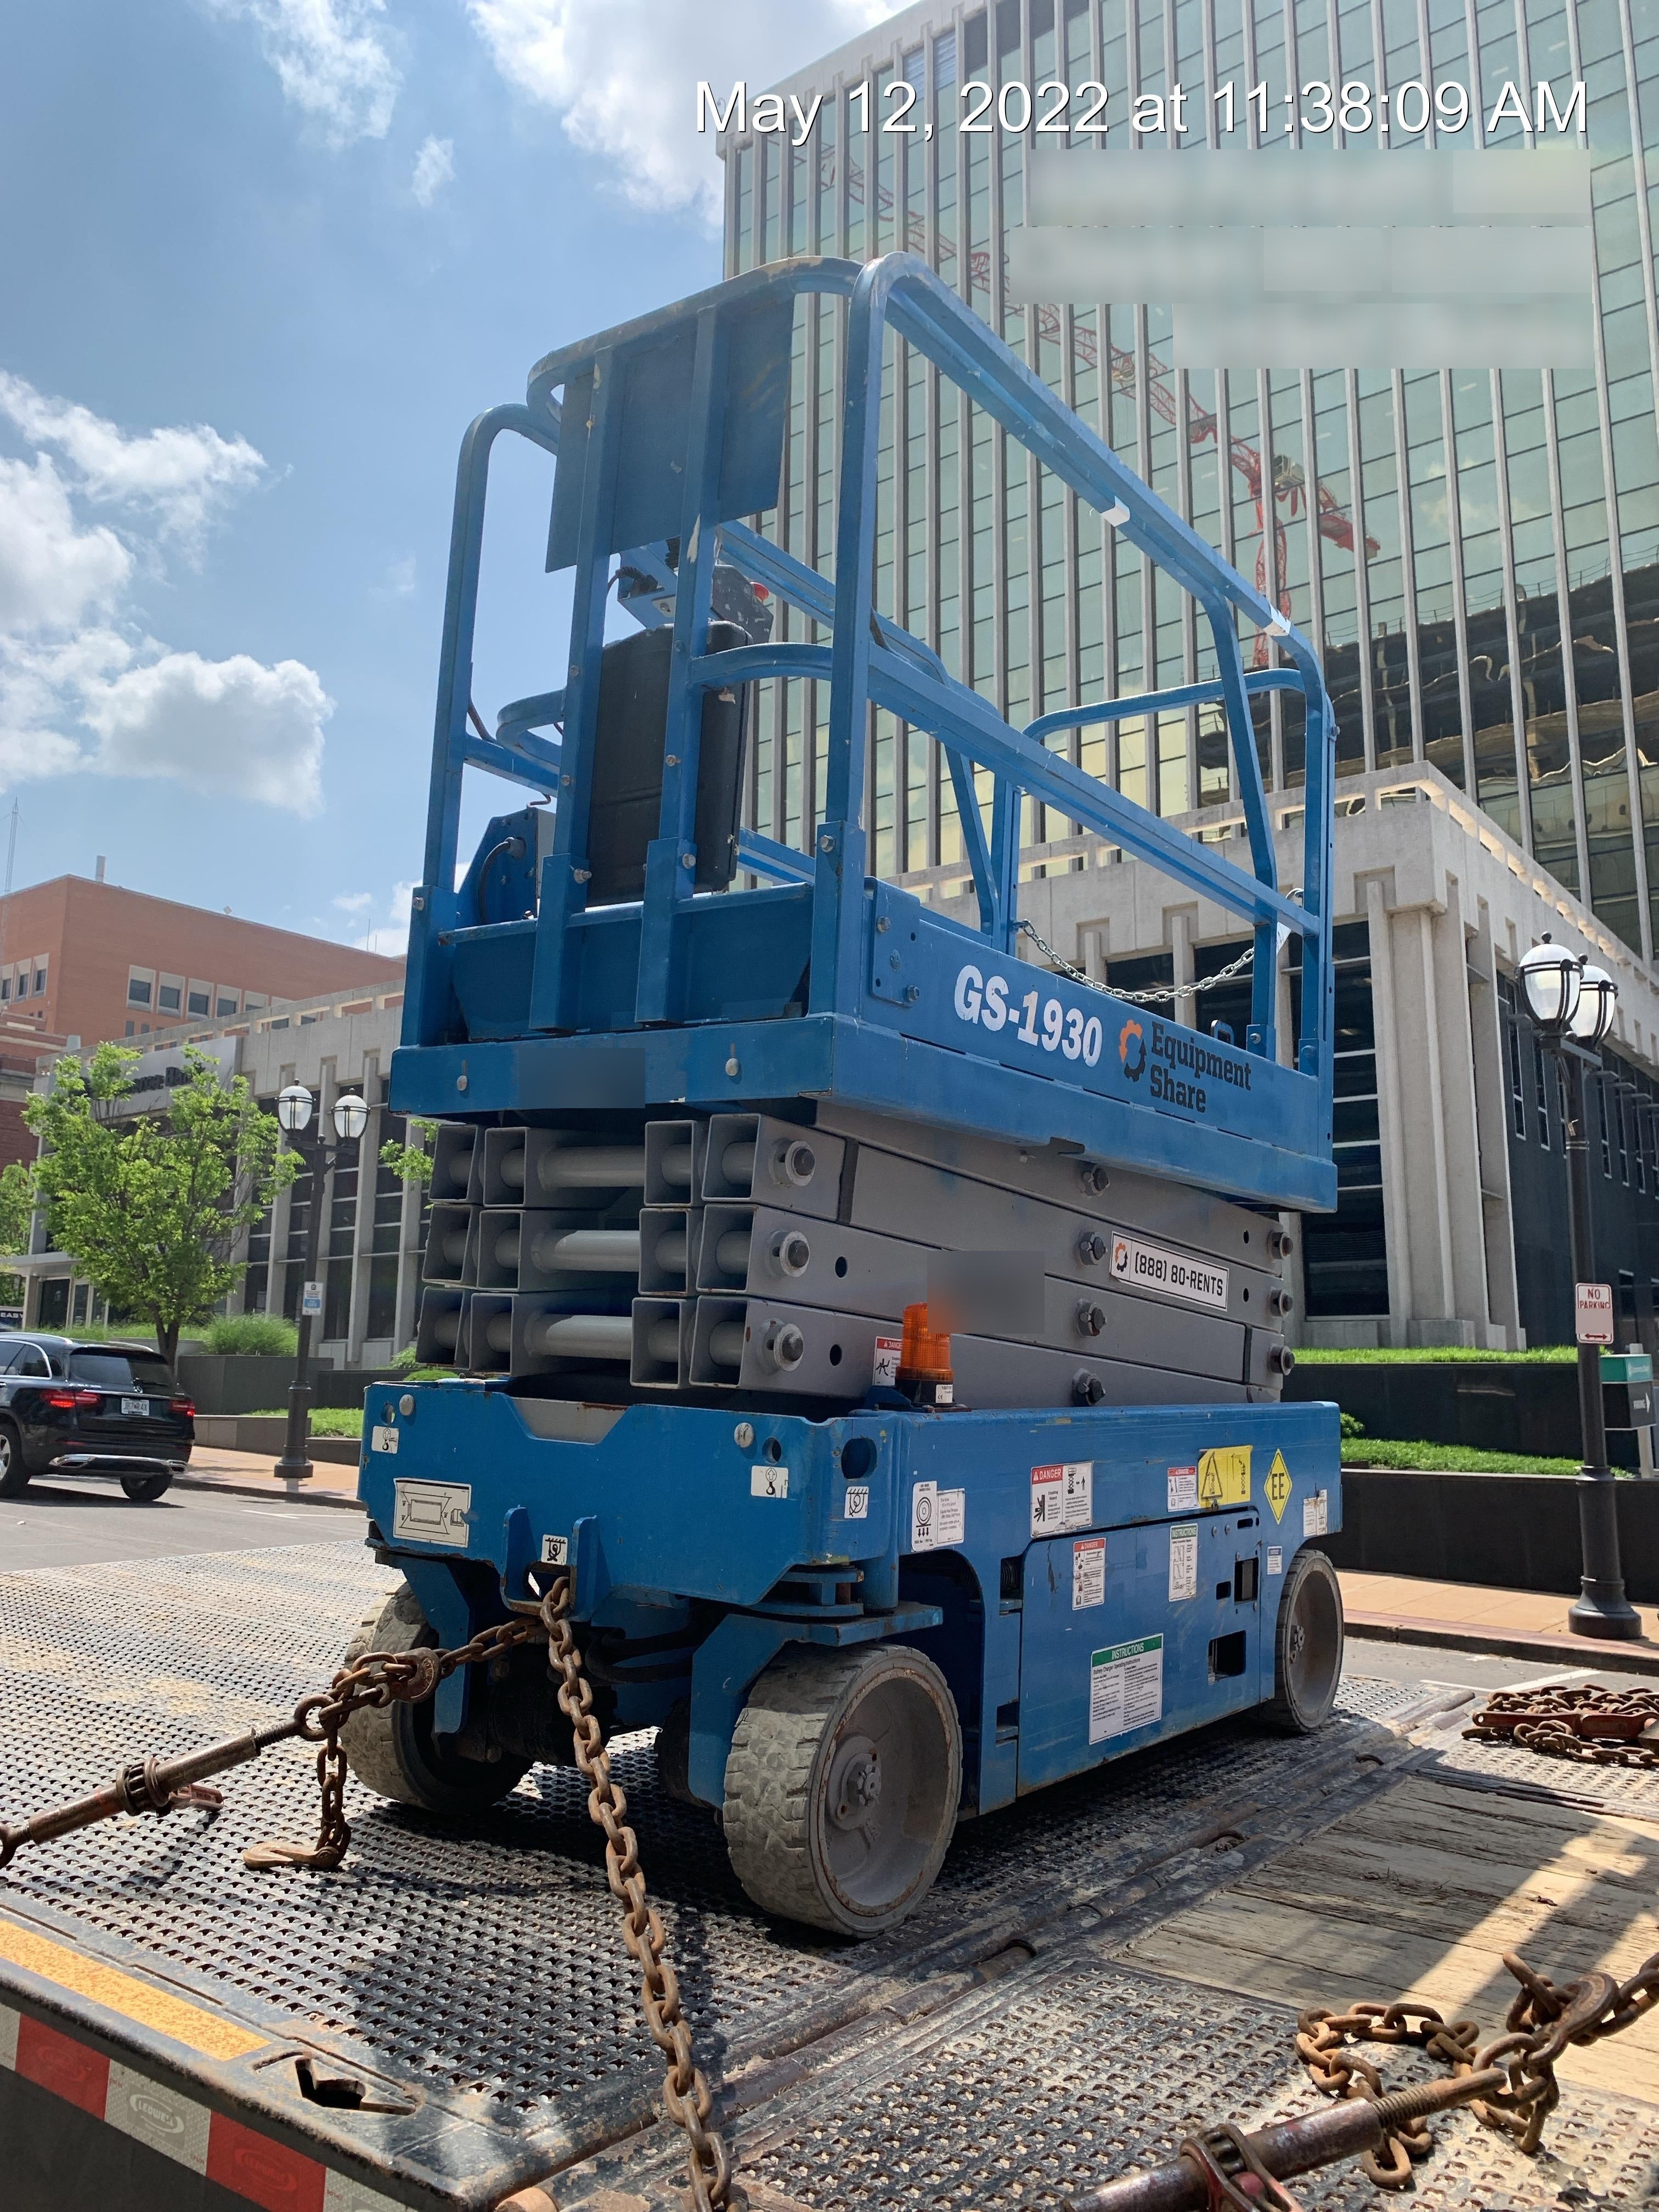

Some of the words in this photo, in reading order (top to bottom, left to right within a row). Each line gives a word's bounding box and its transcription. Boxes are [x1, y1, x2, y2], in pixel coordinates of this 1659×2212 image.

[954, 964, 1103, 1067] GS-1930
[1152, 1021, 1251, 1091] Equipment
[1150, 1064, 1206, 1113] Share
[1135, 1251, 1167, 1282] (888)
[1171, 1265, 1223, 1296] 80-RENTS
[1588, 1289, 1600, 1300] NO
[888, 1341, 902, 1349] DANGE
[1039, 1468, 1062, 1480] DANGER
[1272, 1472, 1285, 1500] EE
[1084, 1541, 1098, 1549] DANGER
[1111, 1643, 1144, 1660] INSTRUCTIONS
